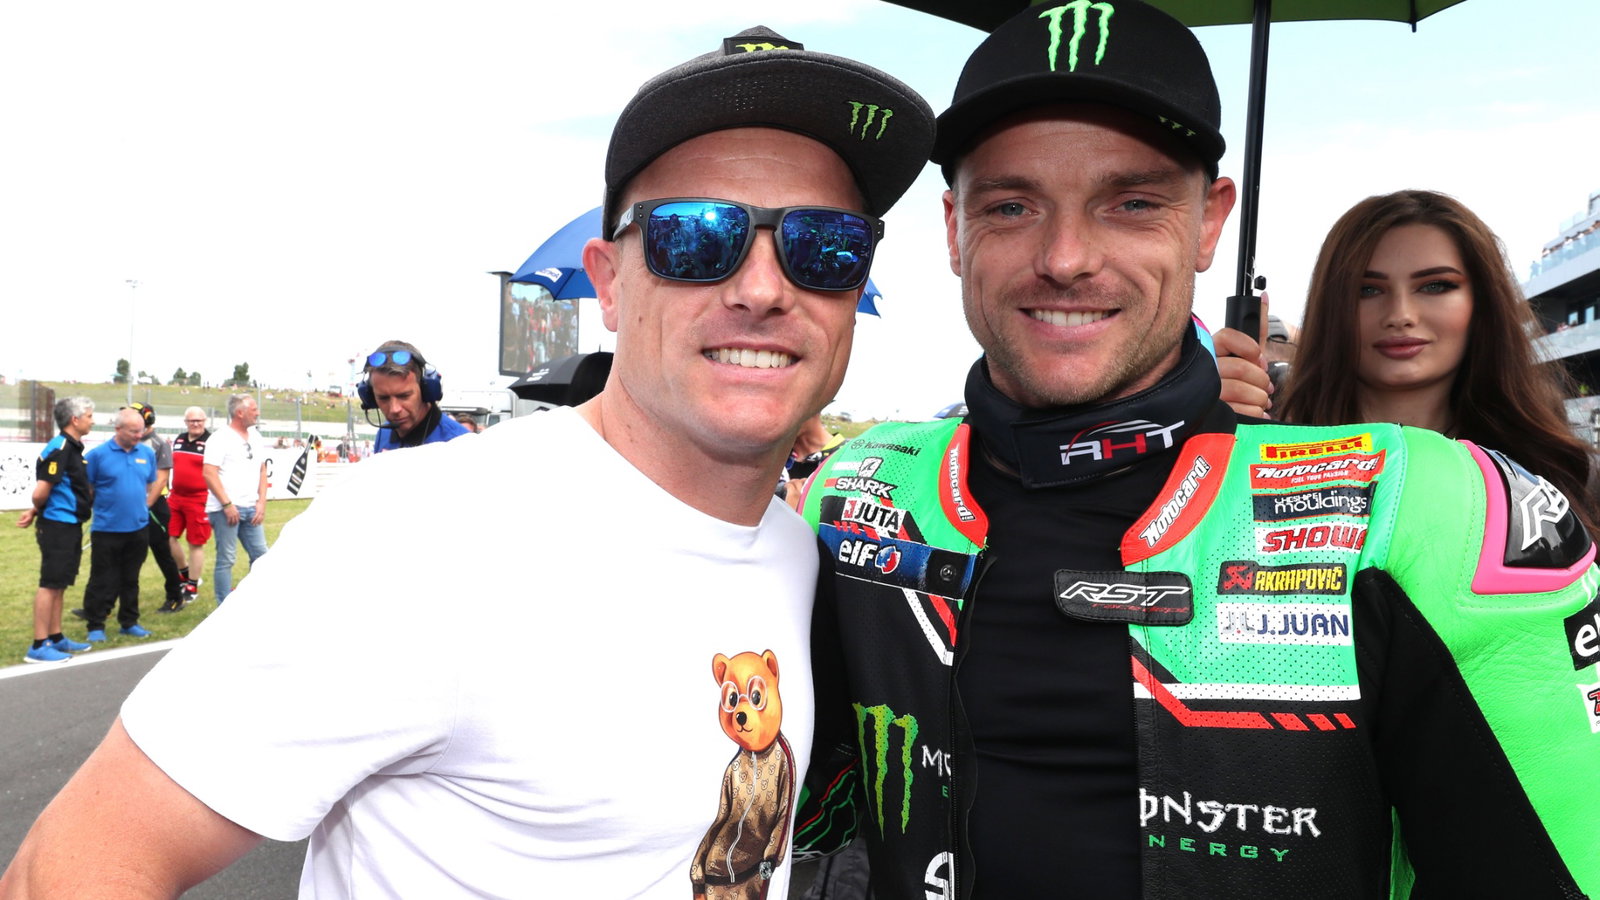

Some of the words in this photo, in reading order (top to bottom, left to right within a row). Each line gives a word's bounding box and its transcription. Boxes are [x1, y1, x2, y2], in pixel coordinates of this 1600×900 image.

[864, 441, 922, 457] Kawasaki
[1265, 436, 1363, 459] PIRELLI
[835, 476, 898, 500] SHARK
[1274, 490, 1368, 514] mouldings
[839, 540, 878, 567] elf
[1060, 581, 1191, 606] RST
